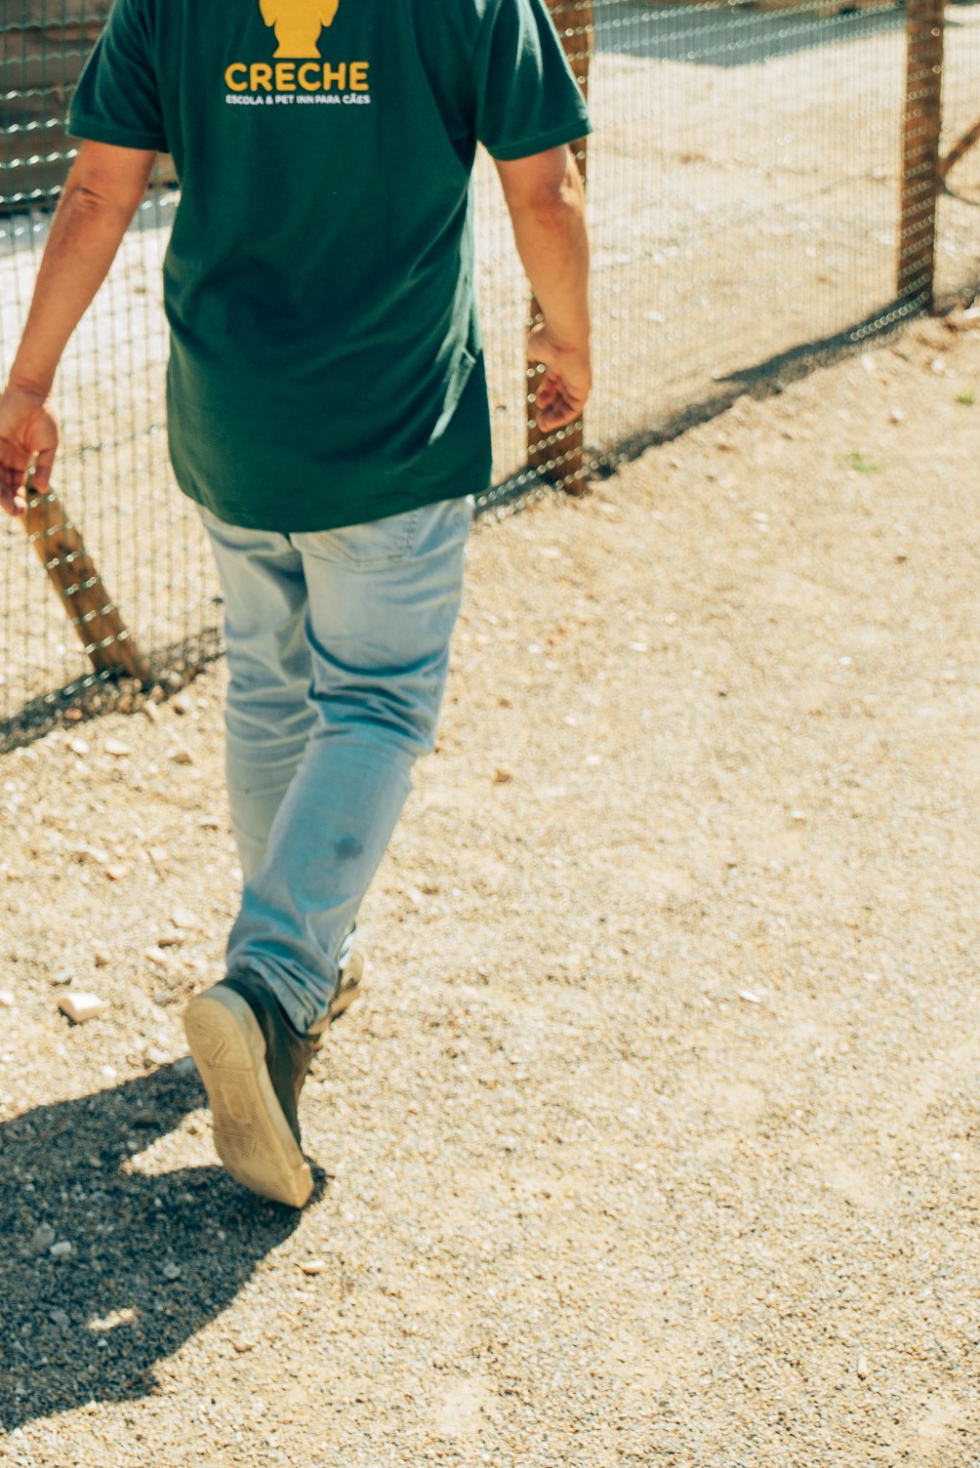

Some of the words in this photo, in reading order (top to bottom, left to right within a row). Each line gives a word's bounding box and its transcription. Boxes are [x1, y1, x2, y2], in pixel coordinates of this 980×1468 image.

[224, 61, 370, 92] CRECHE
[225, 94, 264, 105] ESCOLA
[265, 95, 274, 105] &
[274, 94, 295, 105] PET
[296, 94, 315, 105] INN
[315, 94, 341, 105] PARA
[342, 92, 371, 105] CÃES
